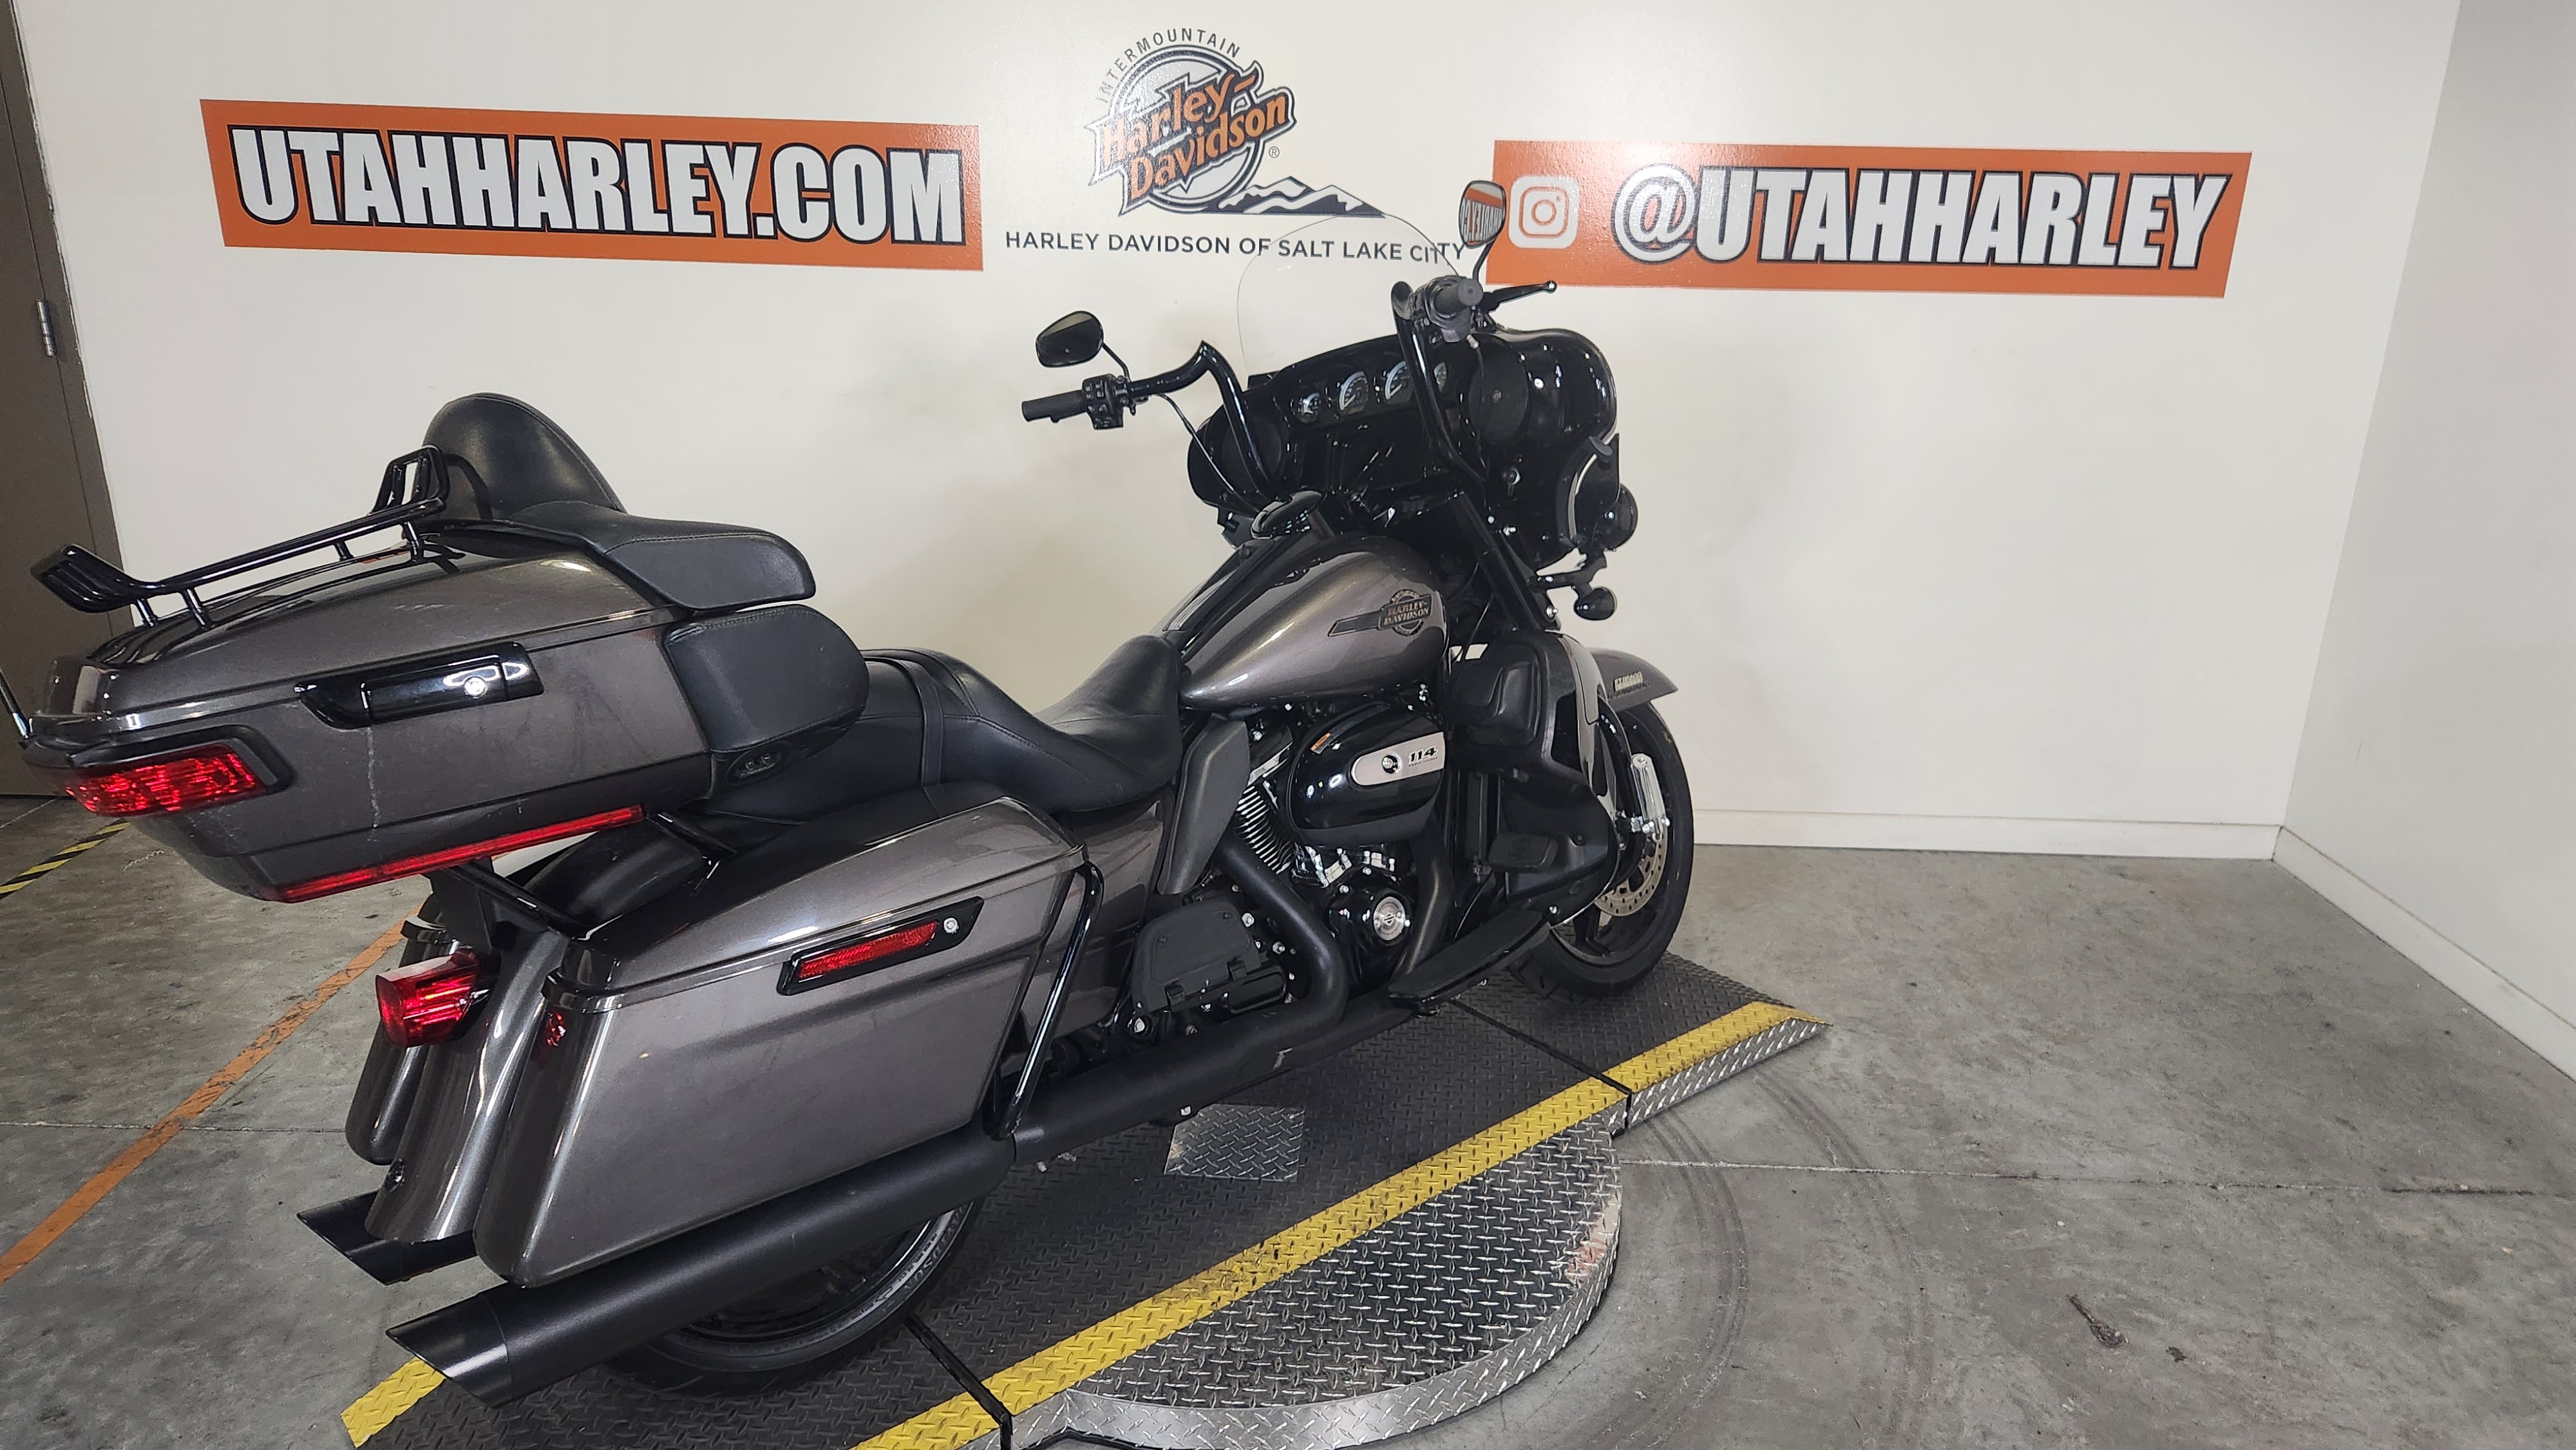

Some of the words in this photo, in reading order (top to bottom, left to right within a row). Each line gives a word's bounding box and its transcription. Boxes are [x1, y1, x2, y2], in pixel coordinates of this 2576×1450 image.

[1096, 28, 1240, 104] INTERMOUNTAIN
[1102, 73, 1256, 170] Harley-
[1131, 95, 1286, 201] Davidson
[227, 124, 967, 246] UTAHHARLEY.COM
[1610, 163, 2233, 271] @UTAHHARLEY
[1005, 231, 1099, 250] HARLEY
[1108, 234, 1230, 254] DAVIDSON
[1238, 237, 1271, 256] OF
[1278, 240, 1335, 258] SALT
[1343, 241, 1403, 261] LAKE
[1410, 241, 1466, 265] CITY
[1409, 746, 1438, 764] 114
